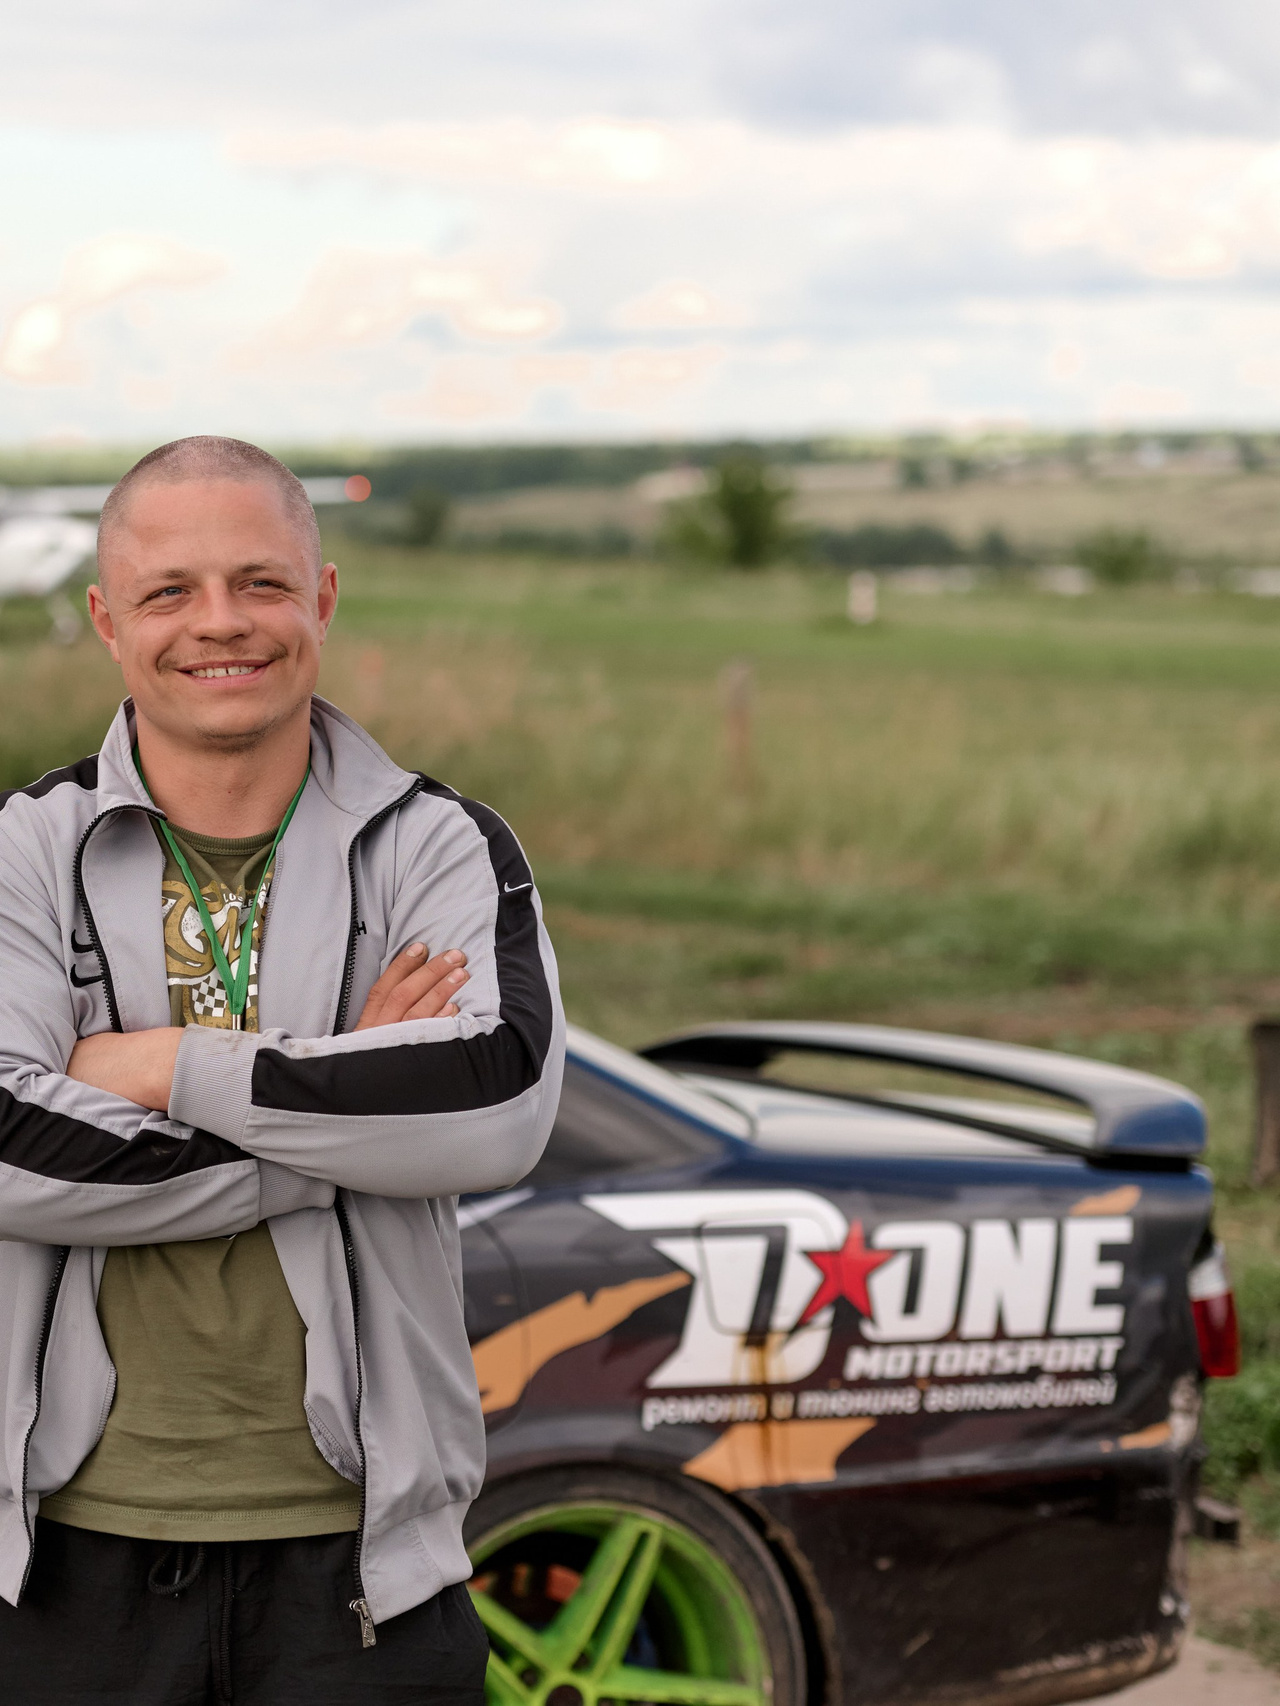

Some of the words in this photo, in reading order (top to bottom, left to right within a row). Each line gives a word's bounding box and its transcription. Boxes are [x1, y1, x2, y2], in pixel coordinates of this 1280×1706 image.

[842, 1337, 1127, 1382] MOTORSPORT
[642, 1391, 768, 1432] ремонт
[771, 1391, 796, 1420] и
[798, 1387, 921, 1418] тюнинг
[923, 1372, 1118, 1414] автомобилей
